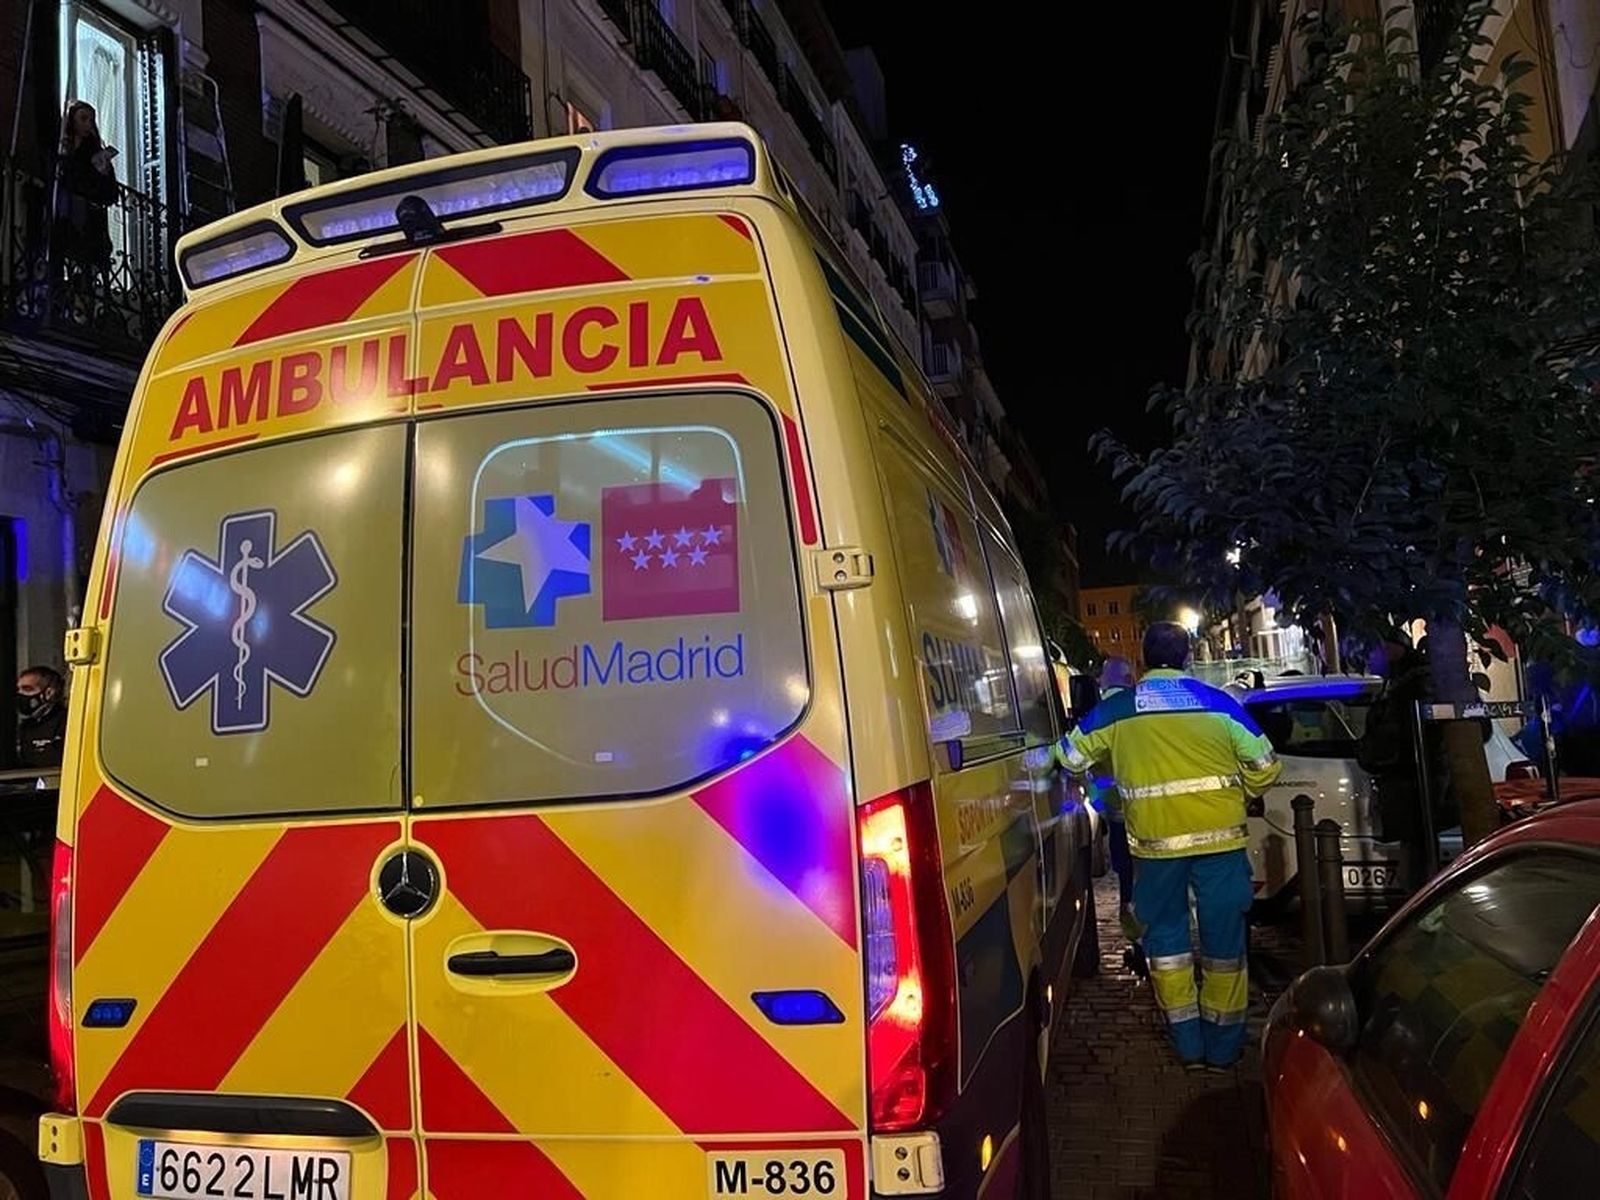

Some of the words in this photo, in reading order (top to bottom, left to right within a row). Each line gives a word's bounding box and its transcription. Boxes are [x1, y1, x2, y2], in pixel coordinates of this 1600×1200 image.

[169, 296, 722, 441] AMBULANCIA
[455, 633, 744, 696] SaludMadrid
[714, 1160, 836, 1195] M-836
